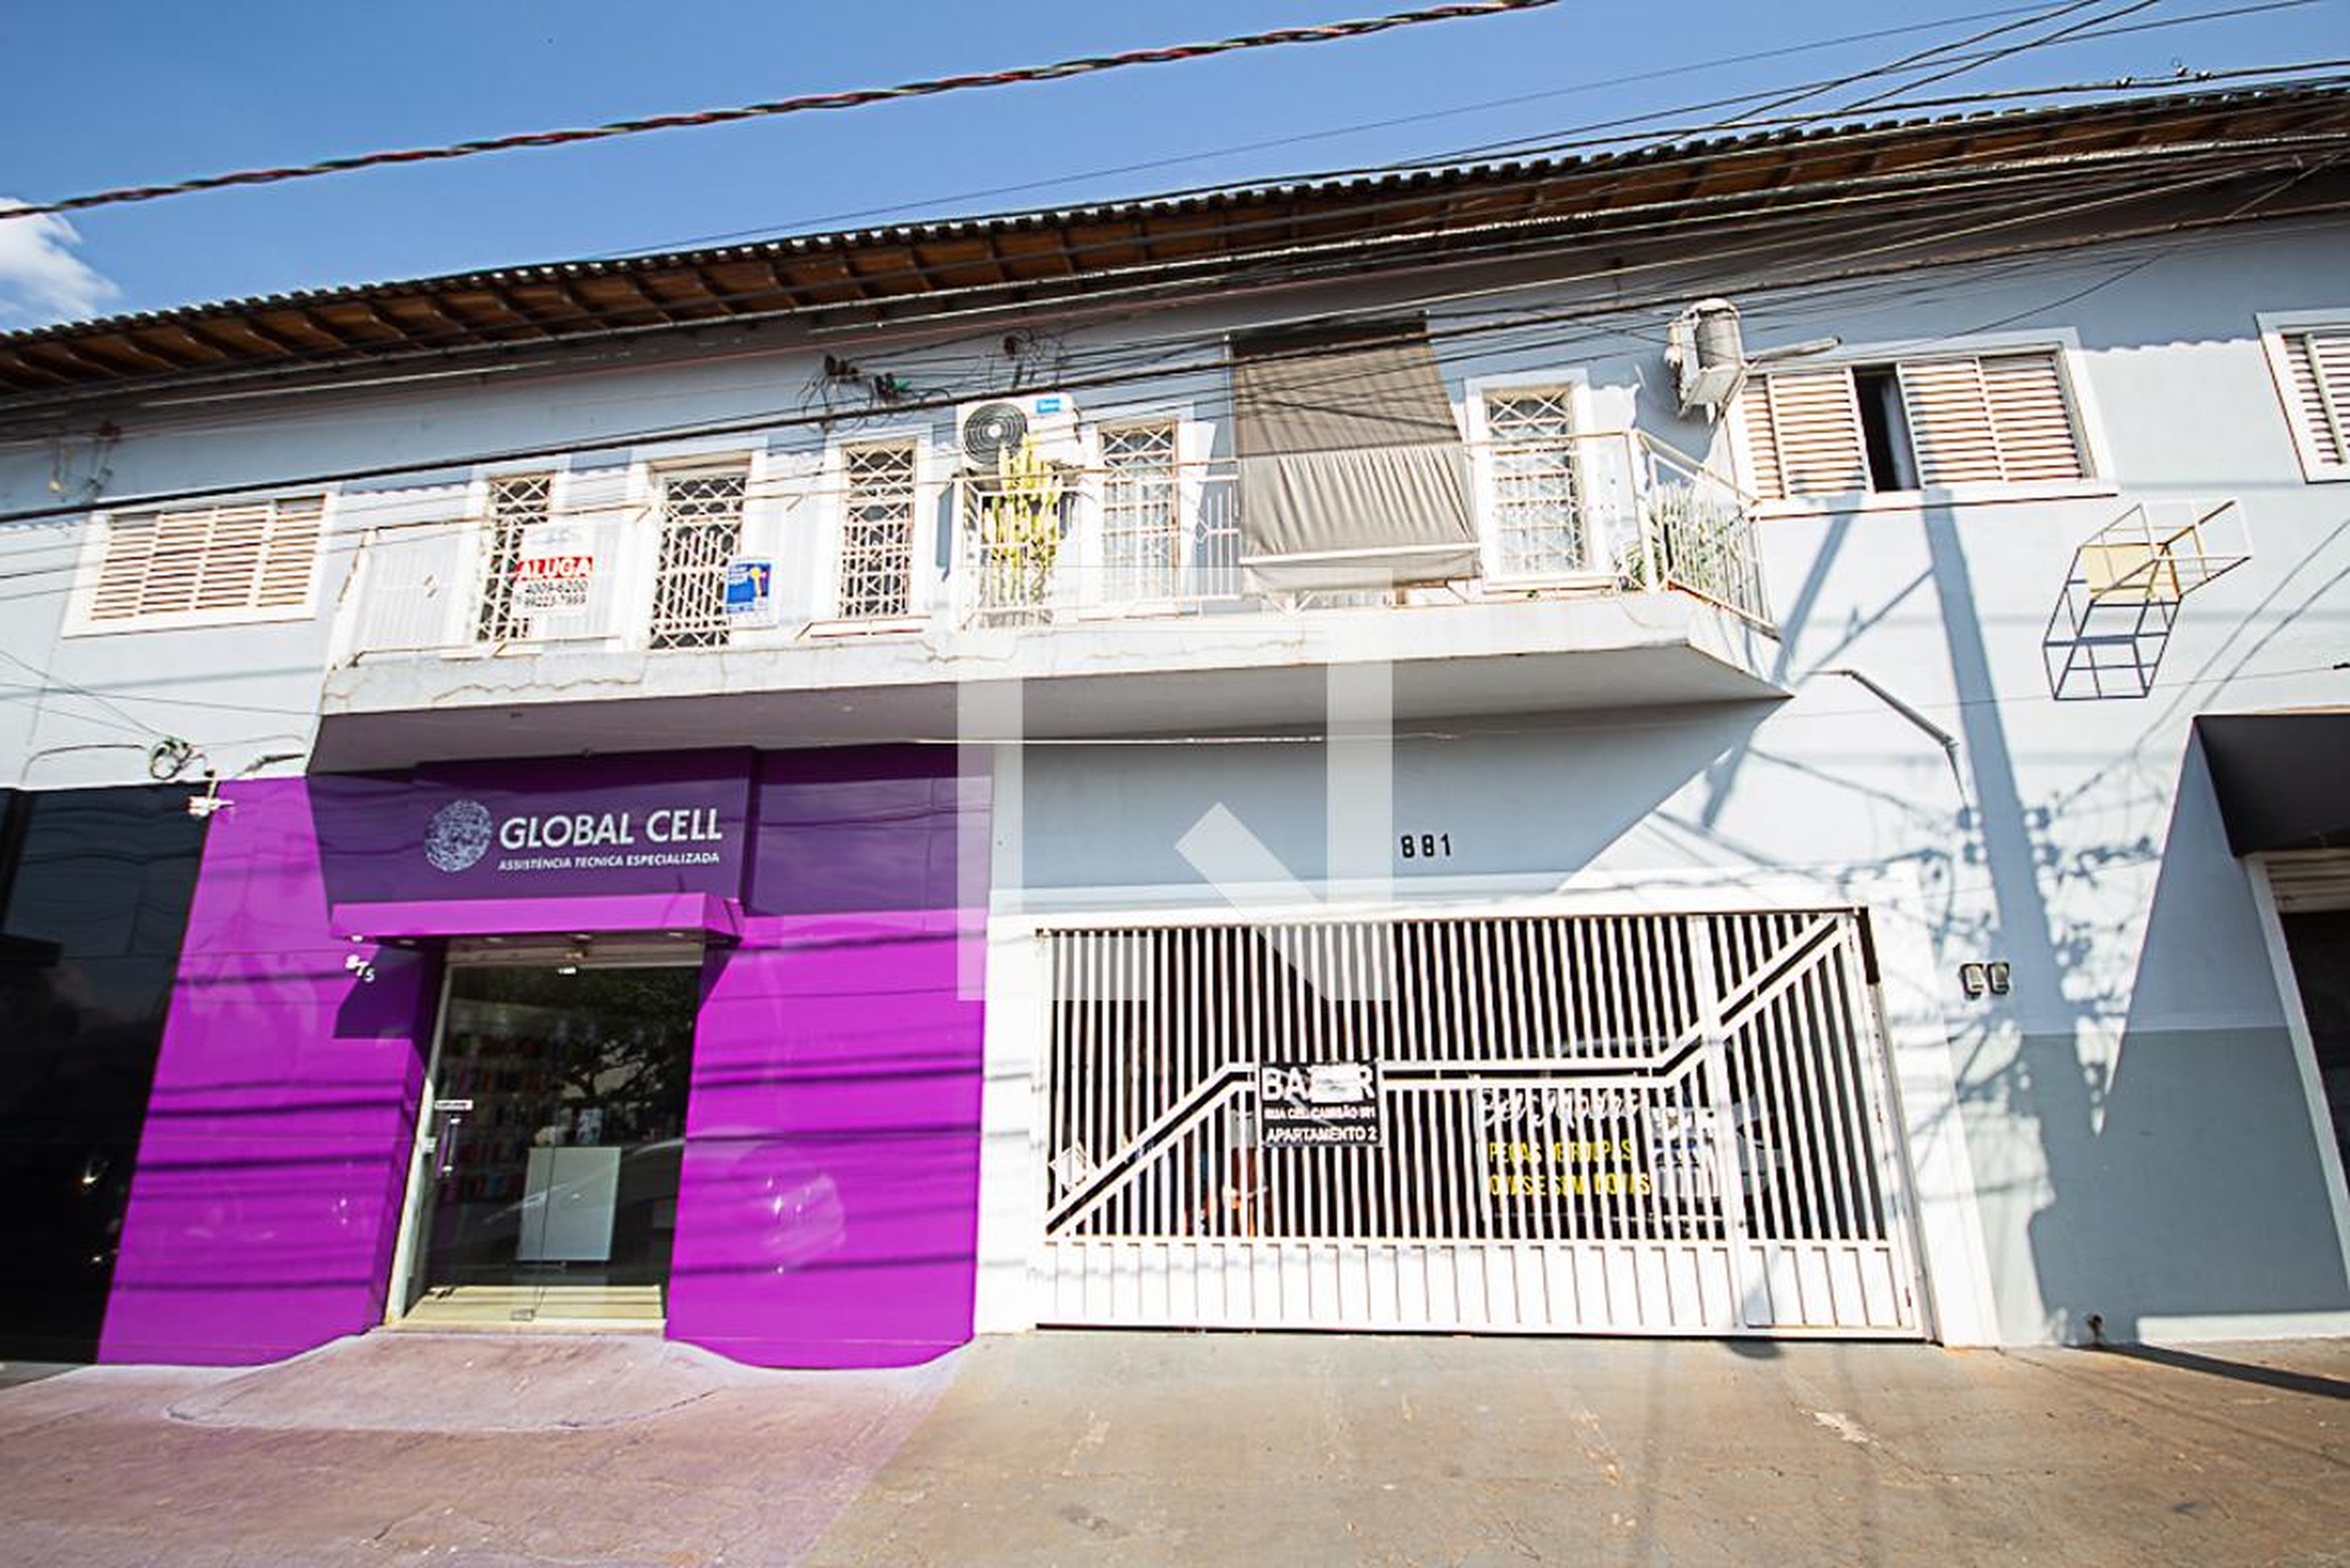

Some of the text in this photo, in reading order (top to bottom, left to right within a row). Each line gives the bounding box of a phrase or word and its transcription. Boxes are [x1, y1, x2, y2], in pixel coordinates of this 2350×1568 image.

[519, 557, 592, 578] ALUGA
[499, 808, 723, 849] GLOBAL CELL
[1401, 833, 1451, 859] 881
[626, 852, 720, 867] ESPECIALIZADA
[1262, 1065, 1375, 1102] BAR
[1266, 1126, 1377, 1143] APARTAMENTO 2
